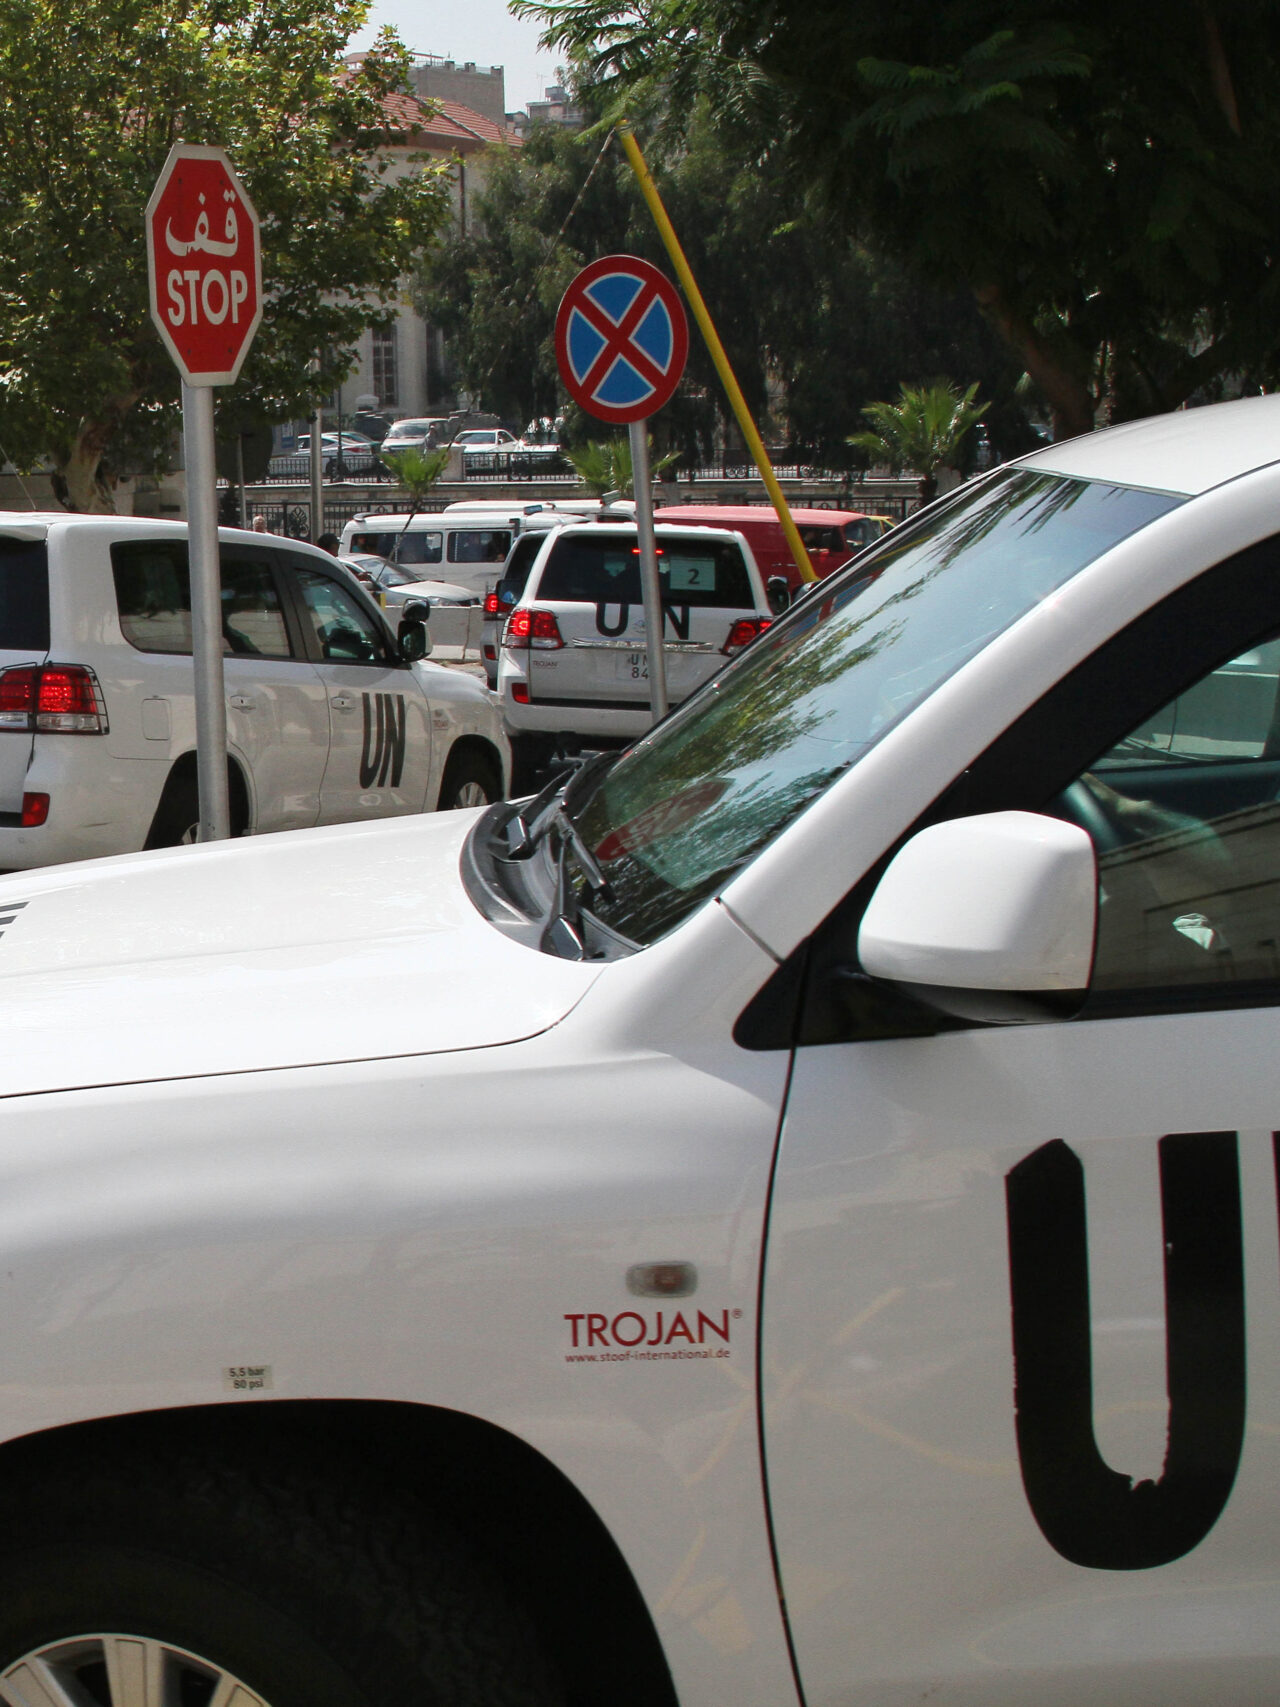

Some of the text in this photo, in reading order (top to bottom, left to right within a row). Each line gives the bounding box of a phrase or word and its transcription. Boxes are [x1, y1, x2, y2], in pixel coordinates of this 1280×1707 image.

[166, 190, 238, 257] قف
[167, 269, 248, 326] STOP
[687, 568, 701, 585] 2
[359, 692, 405, 789] UN
[565, 1348, 731, 1363] www.stoof-international.de
[1005, 1130, 1280, 1571] U
[248, 1366, 265, 1377] bar
[248, 1378, 264, 1391] psi
